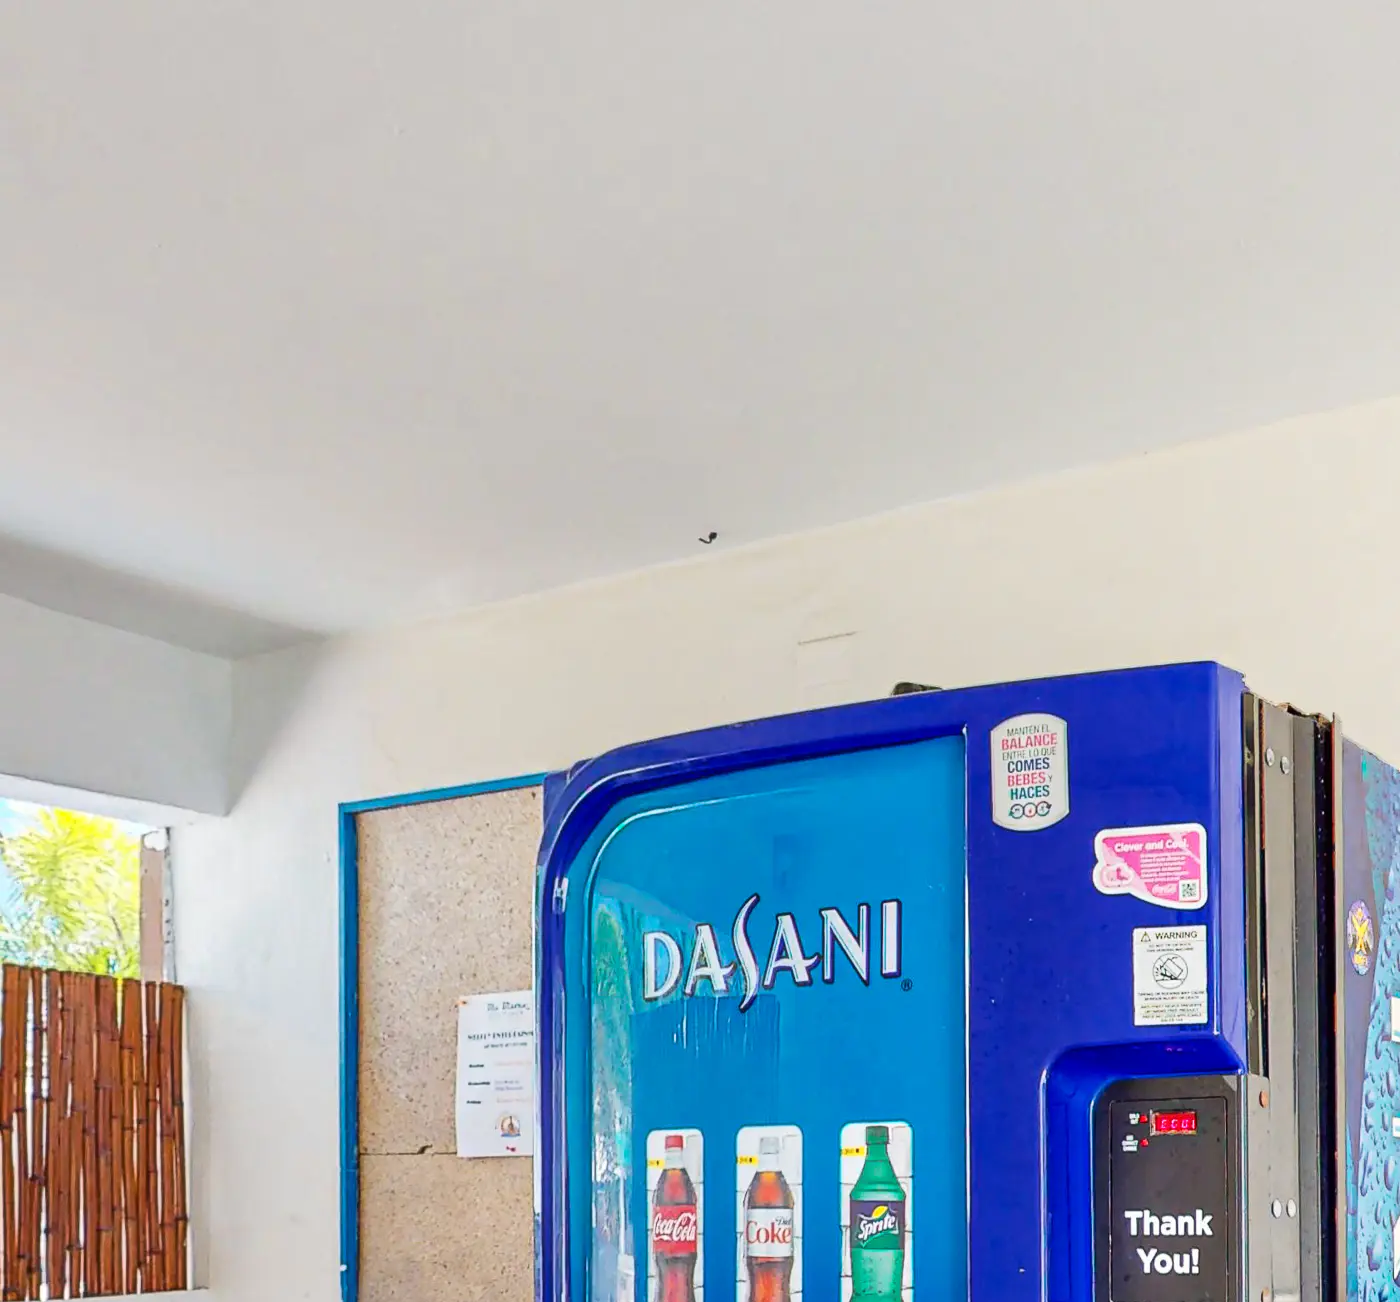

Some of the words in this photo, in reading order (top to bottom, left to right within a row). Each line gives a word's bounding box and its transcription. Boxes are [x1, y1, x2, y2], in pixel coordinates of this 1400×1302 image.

[1002, 733, 1058, 751] BALANCE
[1041, 747, 1056, 757] QUE
[1007, 757, 1050, 773] COMES
[1007, 772, 1046, 787] BEBES
[1010, 785, 1050, 800] HACES
[1144, 840, 1164, 850] and
[1155, 931, 1198, 940] WARNING
[643, 893, 901, 1012] DASANI
[653, 1212, 696, 1242] Coca-Cola
[857, 1213, 896, 1241] Sprite
[1124, 1209, 1213, 1236] Thank
[746, 1220, 792, 1244] Coke
[1136, 1248, 1200, 1274] You!
